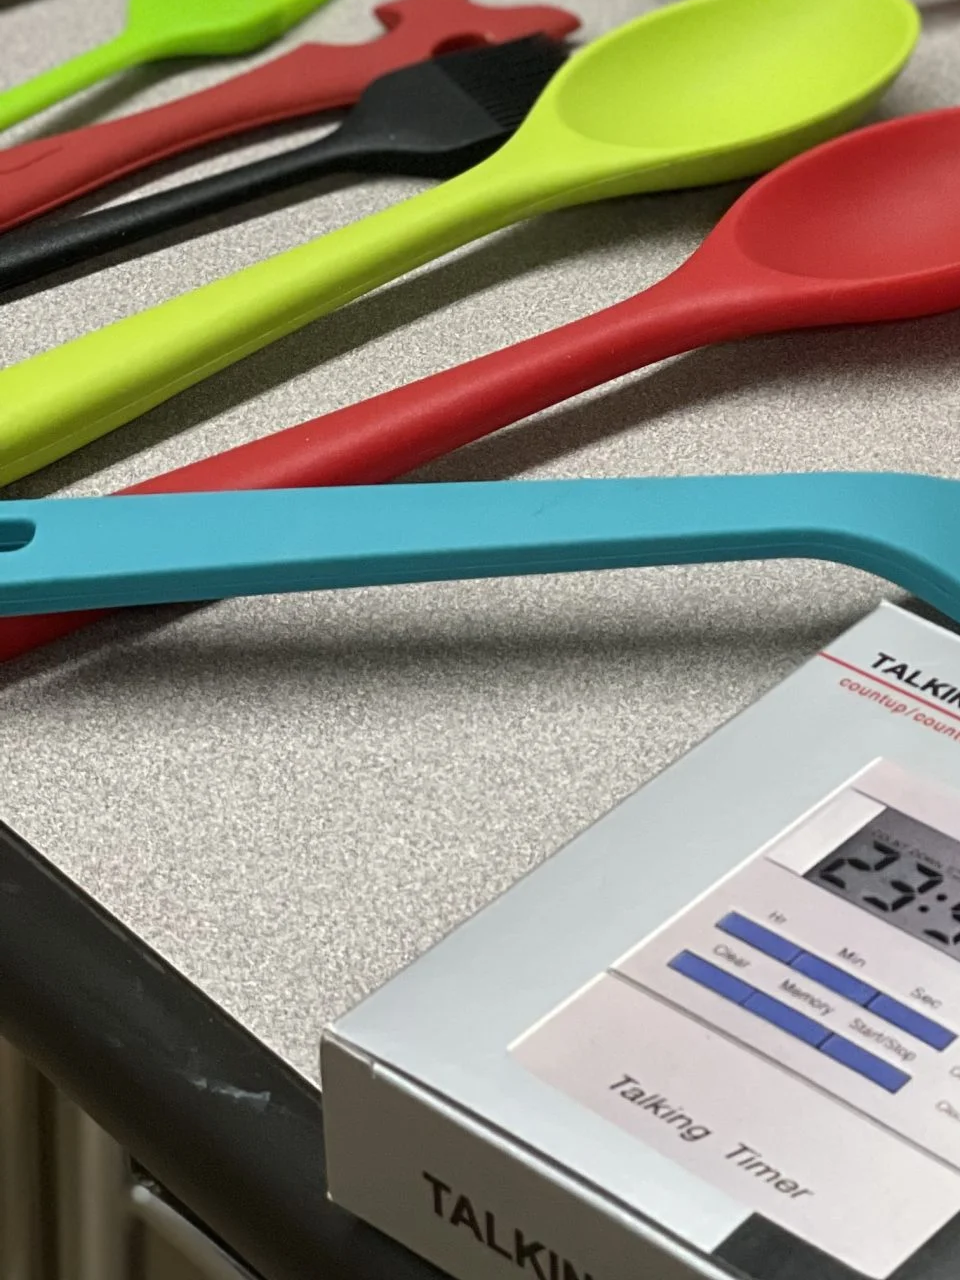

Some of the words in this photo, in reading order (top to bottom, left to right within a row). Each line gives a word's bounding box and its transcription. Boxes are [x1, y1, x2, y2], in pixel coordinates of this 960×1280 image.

[712, 943, 750, 969] Clear
[780, 978, 835, 1016] Memory
[848, 1017, 917, 1063] Start/Stop
[768, 911, 788, 925] Hr
[836, 947, 867, 968] Min
[909, 986, 943, 1010] Sec
[607, 1073, 713, 1143] Talking
[724, 1141, 815, 1201] Timer
